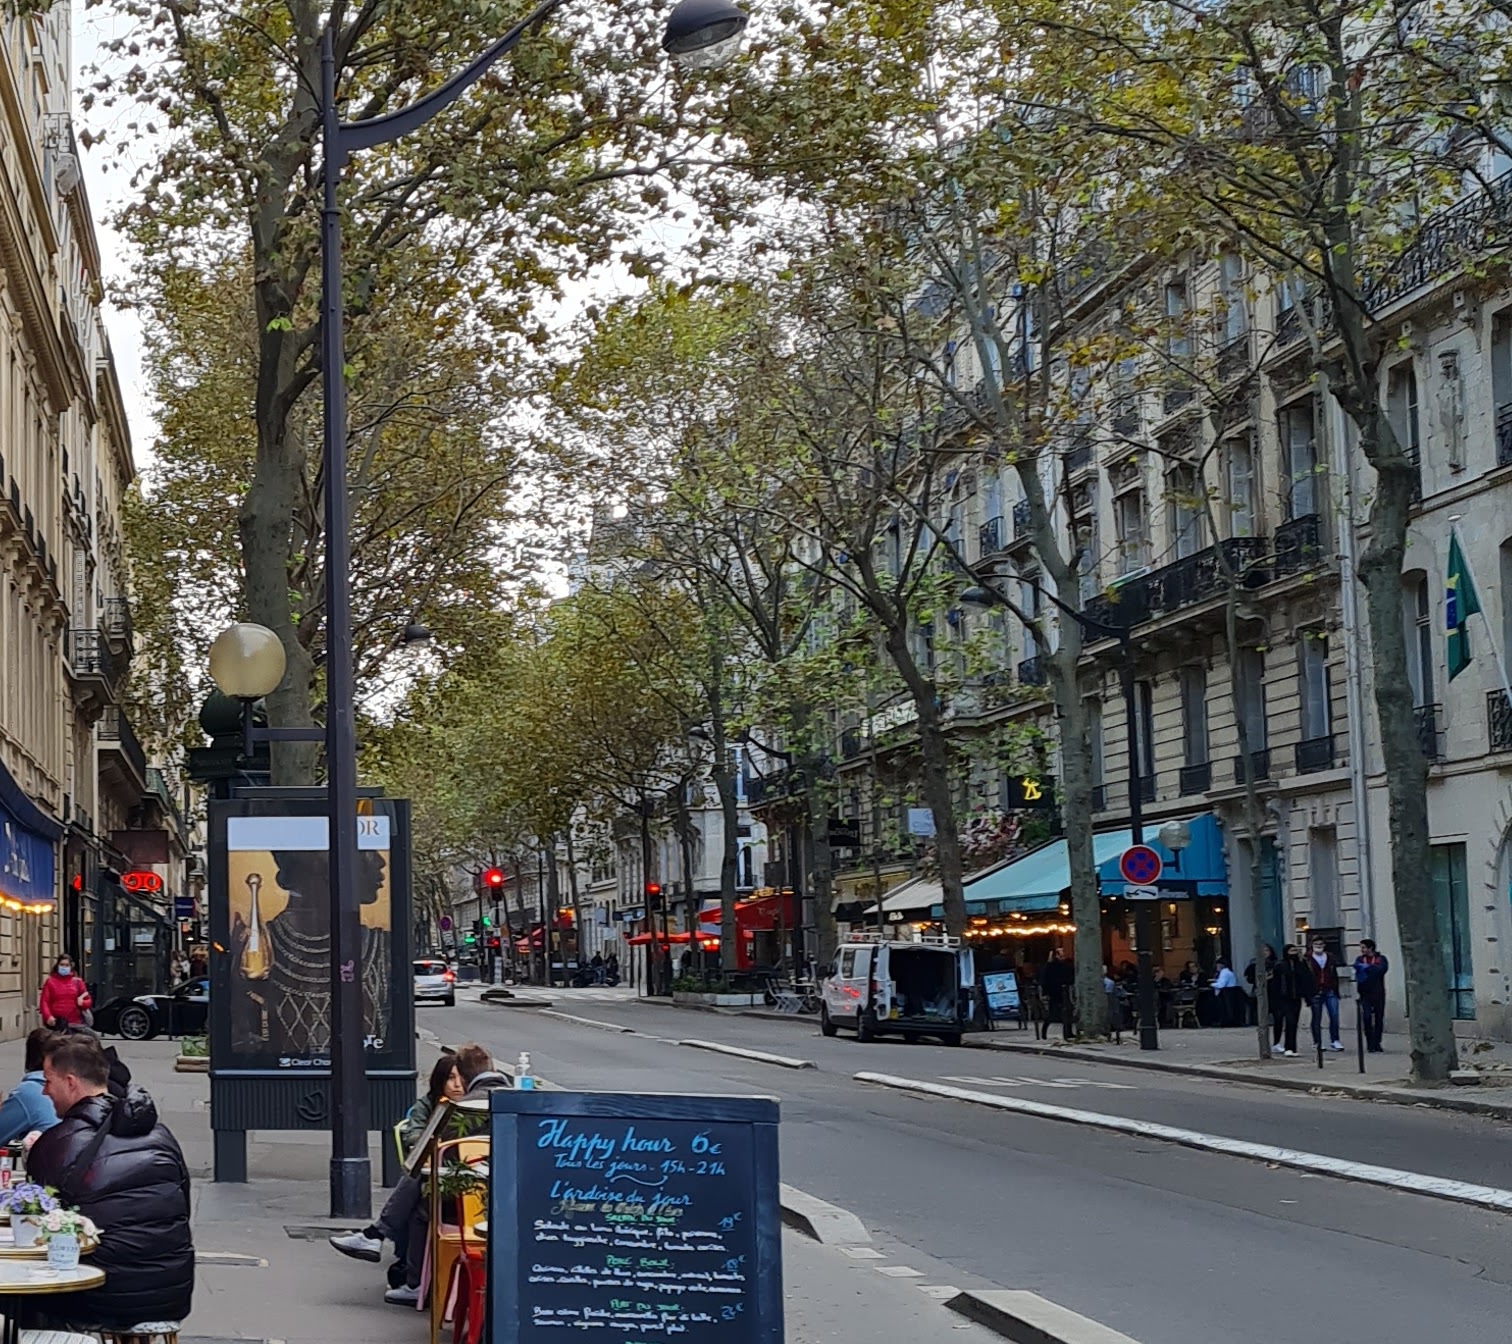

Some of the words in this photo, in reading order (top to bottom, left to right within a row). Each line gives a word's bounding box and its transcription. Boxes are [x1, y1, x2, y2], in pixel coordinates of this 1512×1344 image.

[537, 1119, 616, 1160] Happy
[621, 1126, 677, 1153] hour
[555, 1154, 582, 1169] Tous
[605, 1155, 647, 1177] jours
[550, 1180, 623, 1203] L'ardoise
[626, 1193, 646, 1204] du
[648, 1186, 693, 1210] jour
